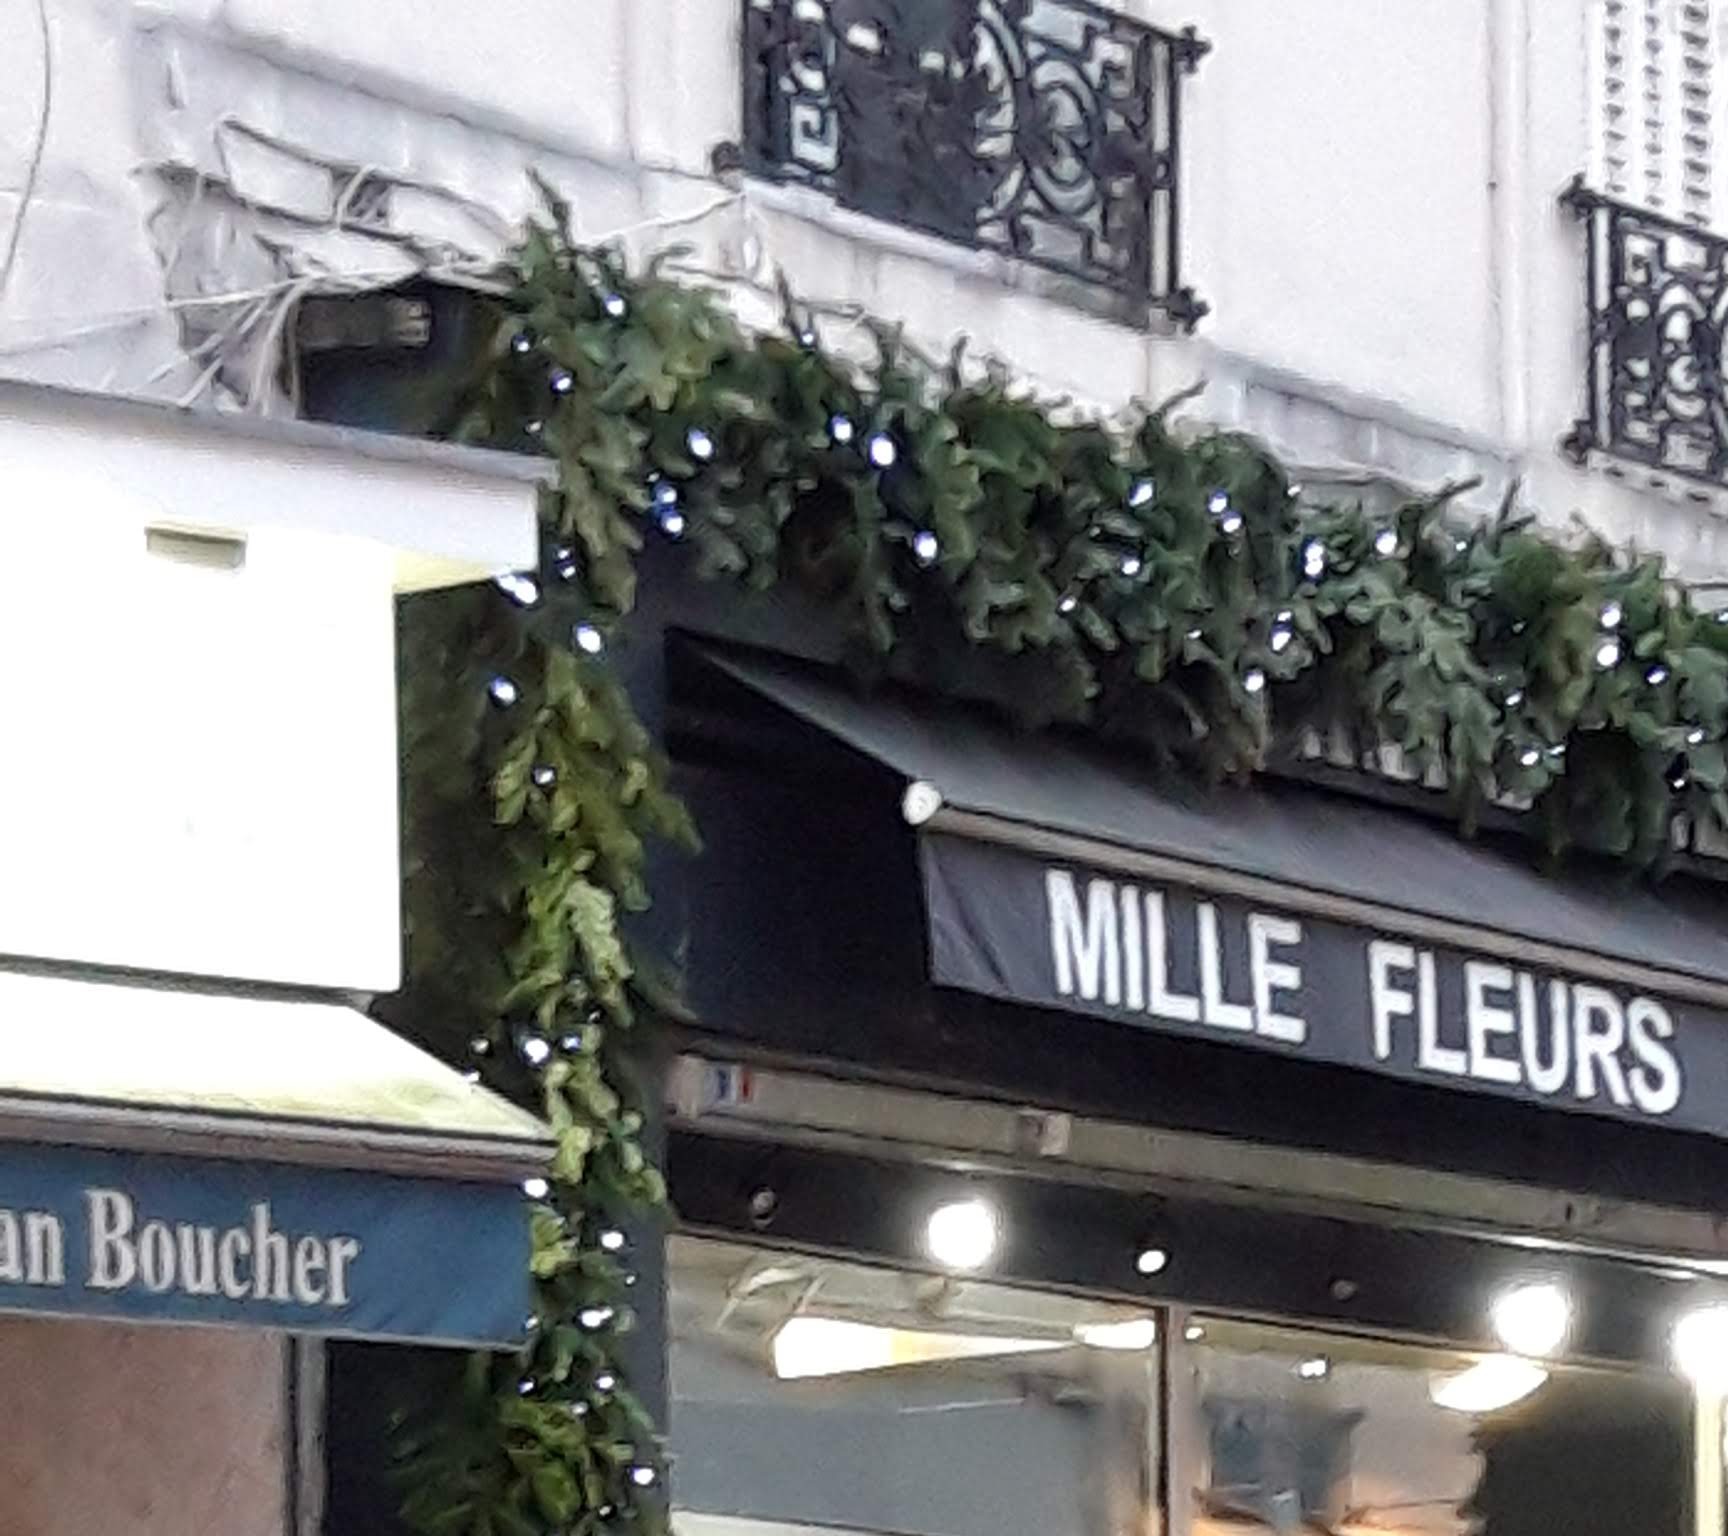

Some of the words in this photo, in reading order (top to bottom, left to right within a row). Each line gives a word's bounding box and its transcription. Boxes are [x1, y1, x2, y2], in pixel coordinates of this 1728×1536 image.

[1044, 868, 1308, 1043] MILLE
[1367, 938, 1683, 1117] FLEURS
[85, 1187, 362, 1307] Boucher
